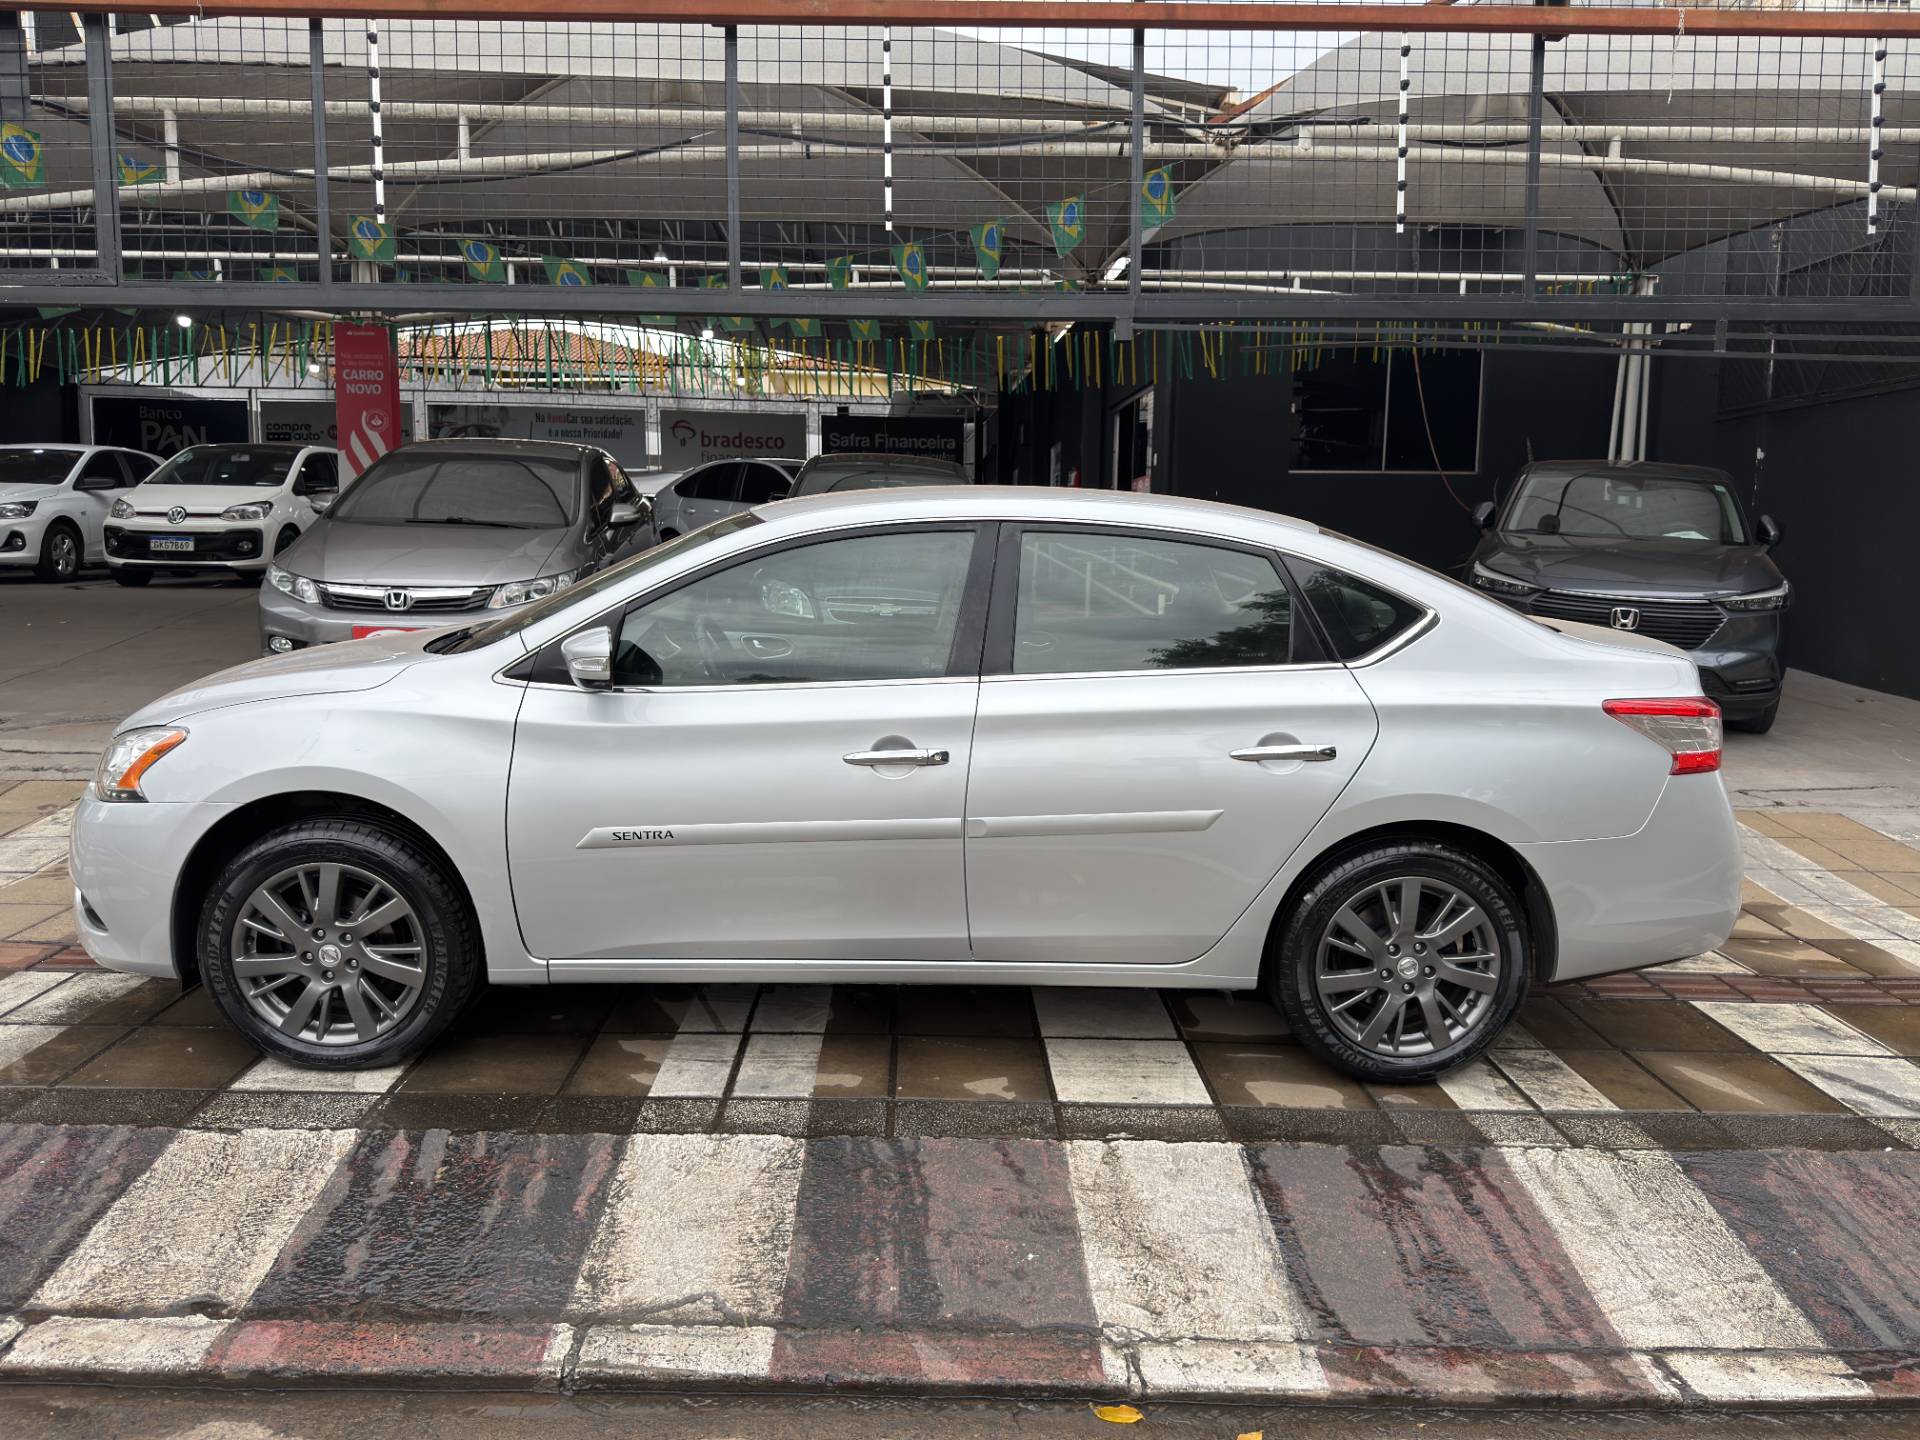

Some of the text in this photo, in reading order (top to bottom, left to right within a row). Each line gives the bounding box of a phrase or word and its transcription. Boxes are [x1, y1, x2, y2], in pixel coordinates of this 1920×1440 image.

[343, 369, 384, 381] CARRO
[345, 383, 382, 395] NOVO
[139, 405, 183, 420] Banco
[265, 423, 312, 433] compre
[141, 421, 207, 450] PAN
[292, 431, 321, 441] auto
[701, 430, 785, 449] bradesco
[829, 432, 956, 449] Safra Financeira
[611, 830, 675, 841] SENTRA
